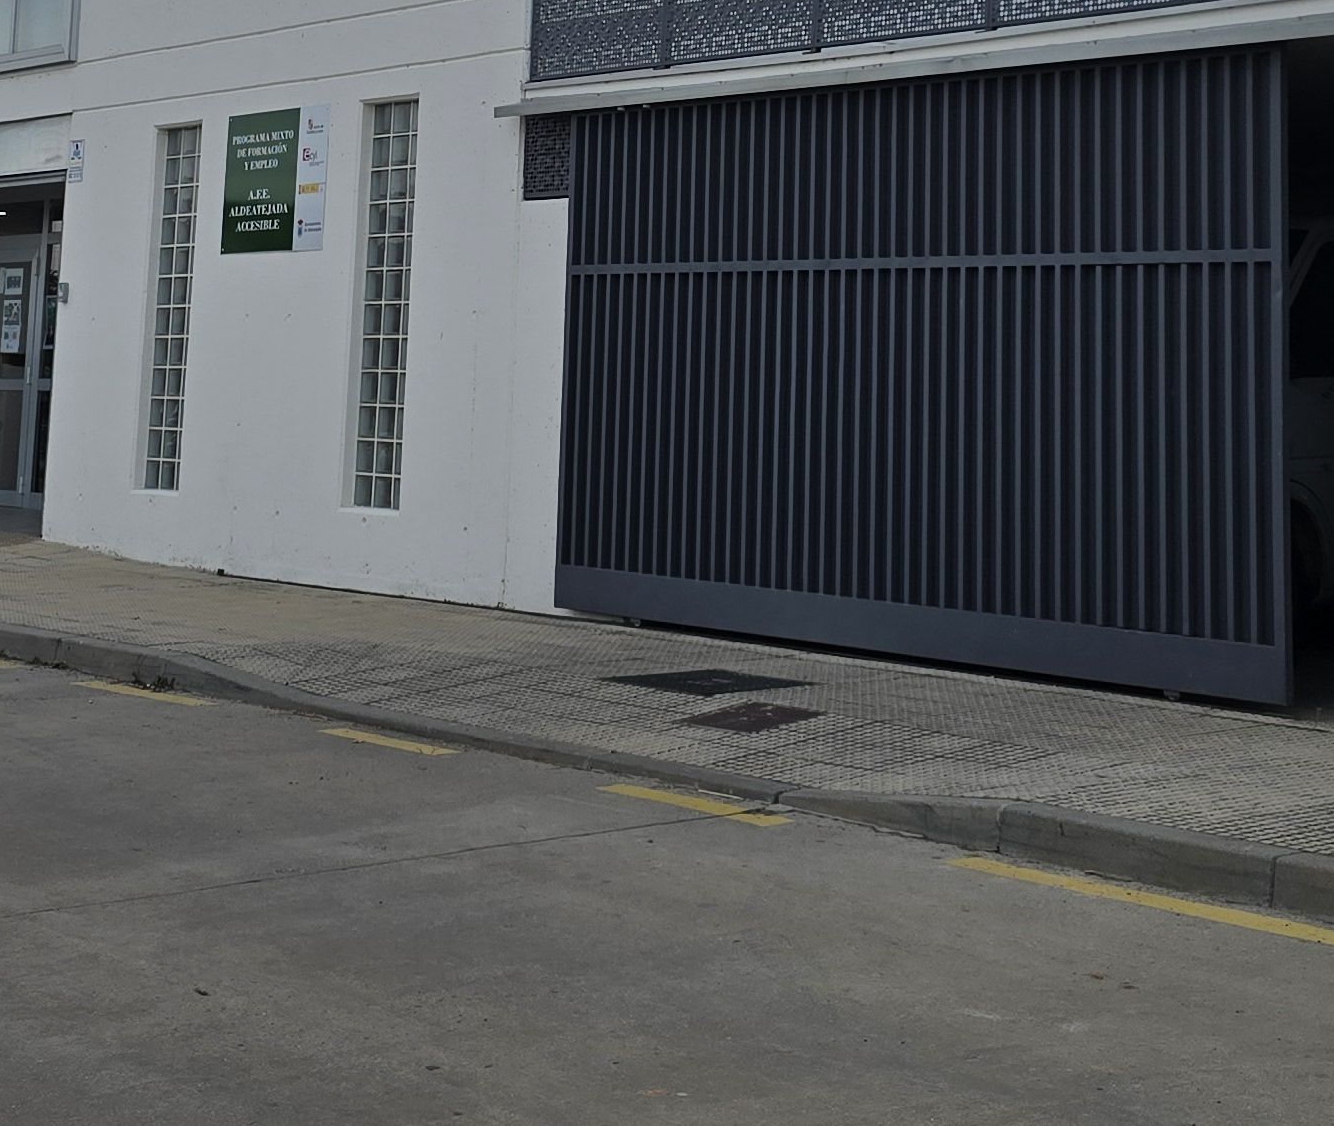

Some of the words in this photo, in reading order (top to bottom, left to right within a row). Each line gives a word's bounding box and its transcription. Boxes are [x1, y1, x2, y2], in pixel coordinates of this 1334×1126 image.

[232, 133, 269, 145] PROGRAMA
[271, 129, 294, 141] MIXTO
[237, 148, 247, 158] DE
[247, 142, 288, 157] FORMACIÓN
[244, 161, 250, 171] Y
[250, 158, 278, 171] EMPLEO
[248, 188, 271, 201] A.F.E.
[229, 203, 288, 217] ALDEATEJADA
[235, 219, 280, 232] ACCESIBLE
